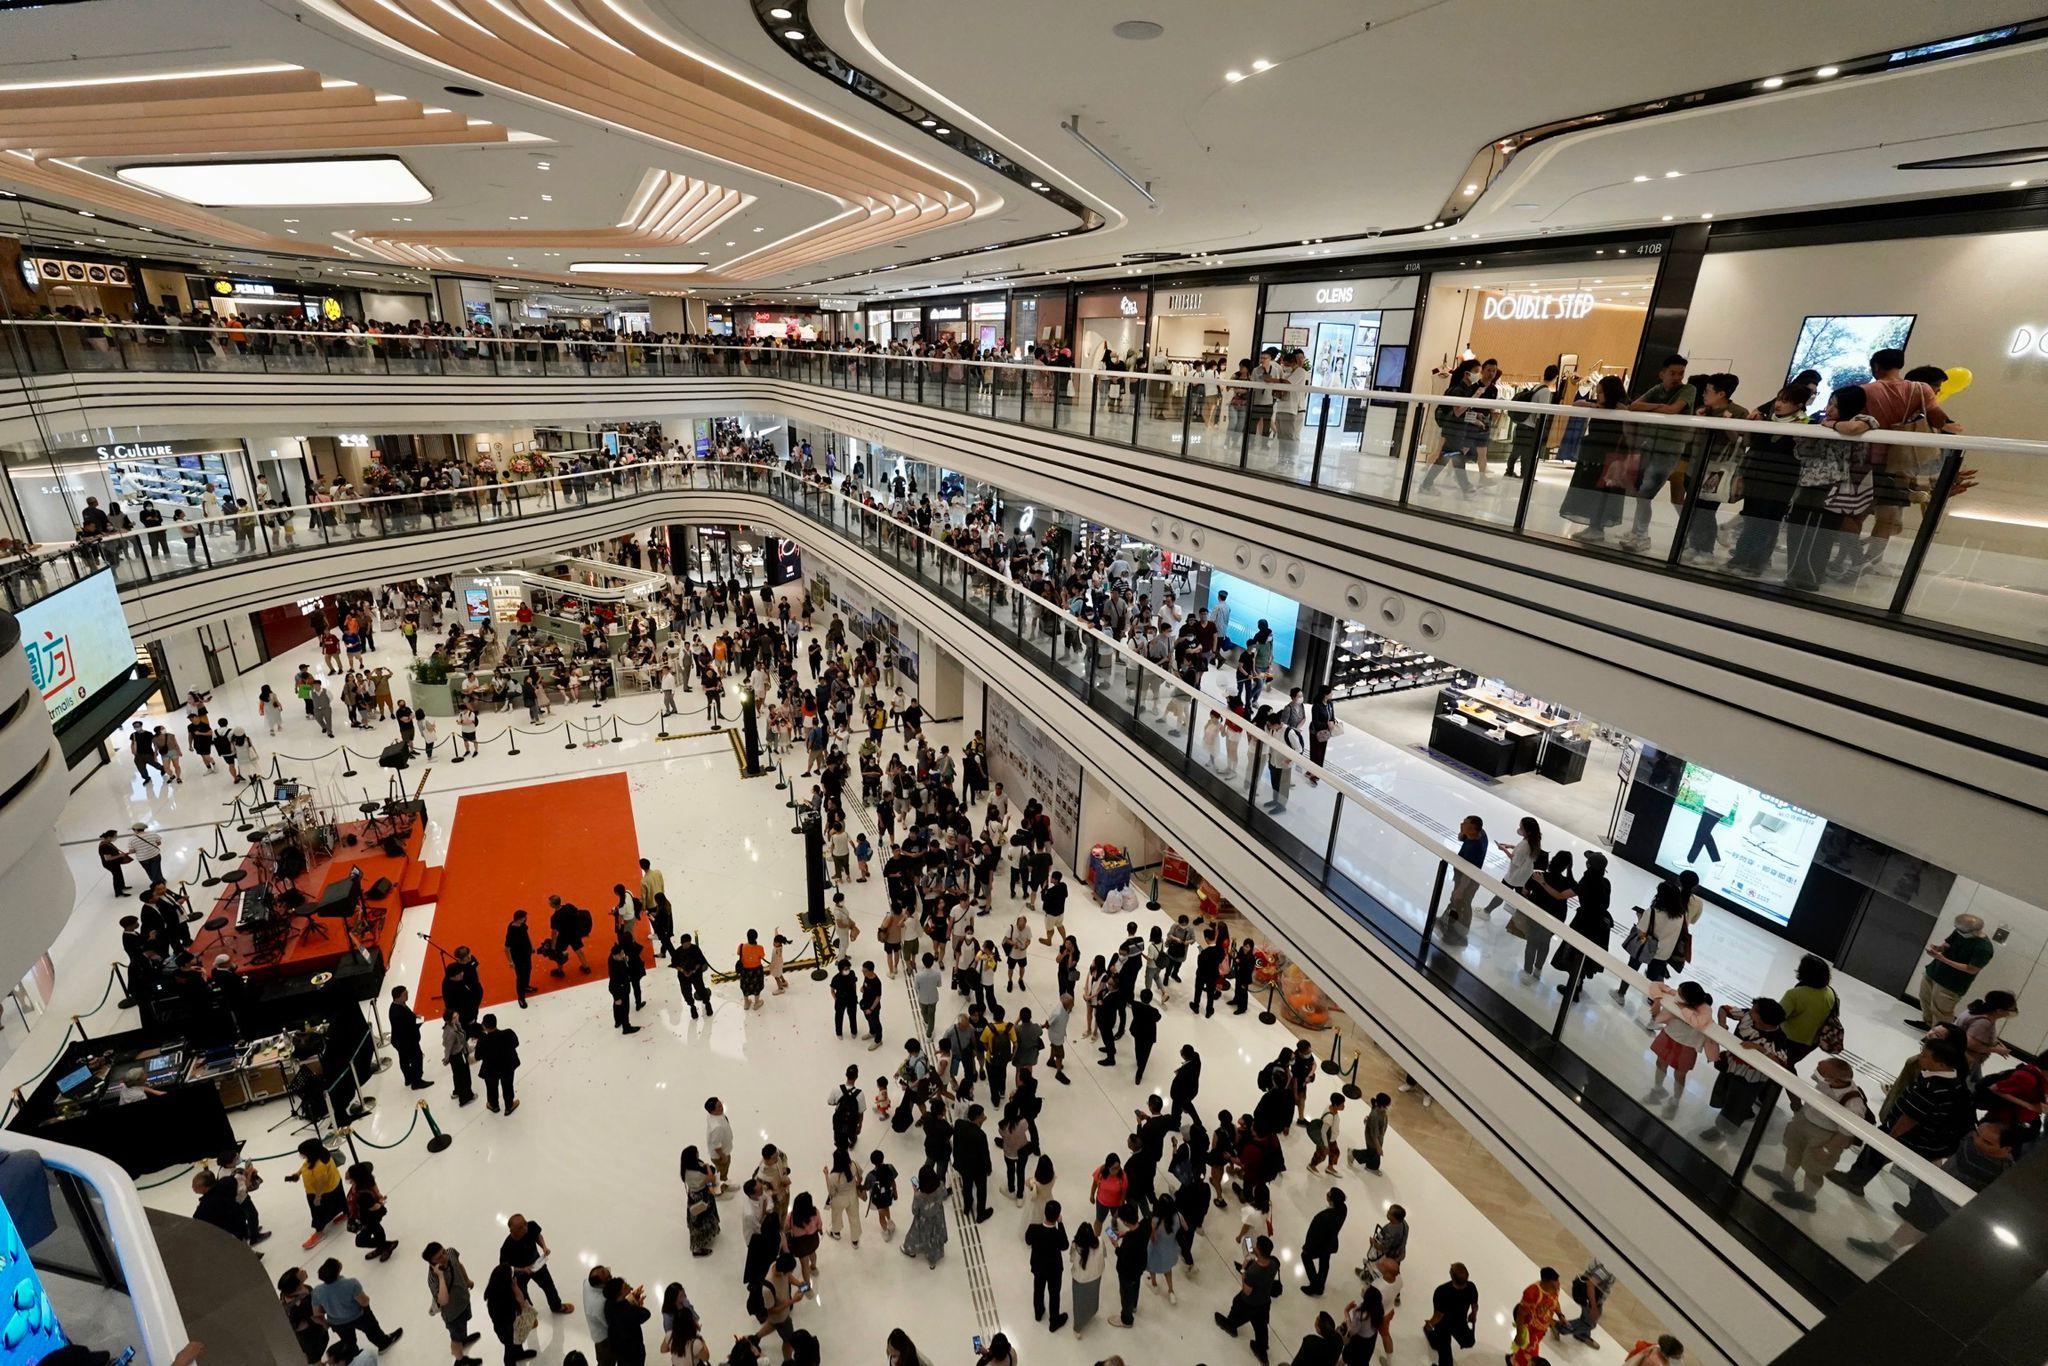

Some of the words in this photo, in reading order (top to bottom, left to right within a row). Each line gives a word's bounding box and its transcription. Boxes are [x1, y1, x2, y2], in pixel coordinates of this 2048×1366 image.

[1637, 243, 1662, 255] 410B
[1404, 263, 1421, 272] 410A
[1316, 287, 1354, 304] OLENS
[1483, 294, 1552, 320] DOUBLE
[1554, 292, 1595, 319] STEP
